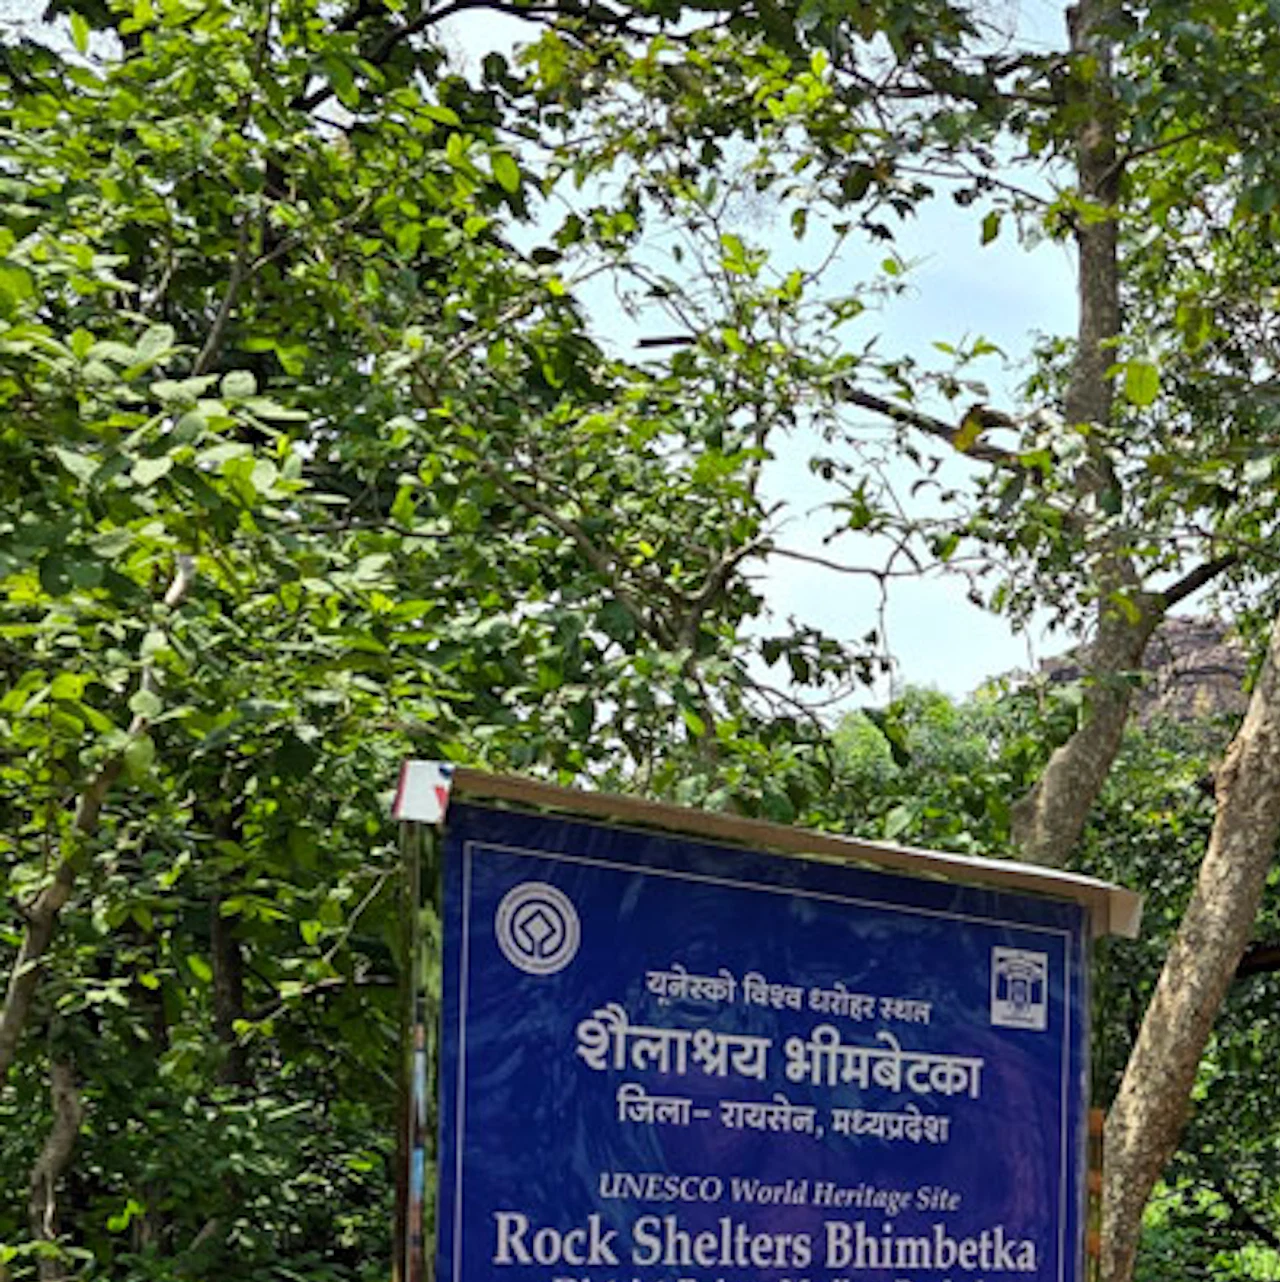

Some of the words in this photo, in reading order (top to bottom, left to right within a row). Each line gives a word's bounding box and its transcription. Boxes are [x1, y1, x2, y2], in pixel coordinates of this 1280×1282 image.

[646, 964, 736, 1006] यूनेस्को
[743, 974, 803, 1009] विश्व
[808, 982, 875, 1020] धरोहर
[879, 996, 931, 1025] स्थल
[575, 1003, 771, 1080] शैलाश्रय
[784, 1025, 984, 1098] भीमबेटका
[720, 1094, 825, 1139] रायसेन,
[832, 1105, 949, 1143] मध्यप्रदेश
[600, 1172, 722, 1202] UNESCO
[730, 1177, 807, 1205] World
[813, 1181, 911, 1215] Heritage
[916, 1186, 961, 1211] Site
[493, 1211, 619, 1267] Rock
[631, 1214, 813, 1270] Shelters
[824, 1220, 1037, 1273] Bhimbetka
